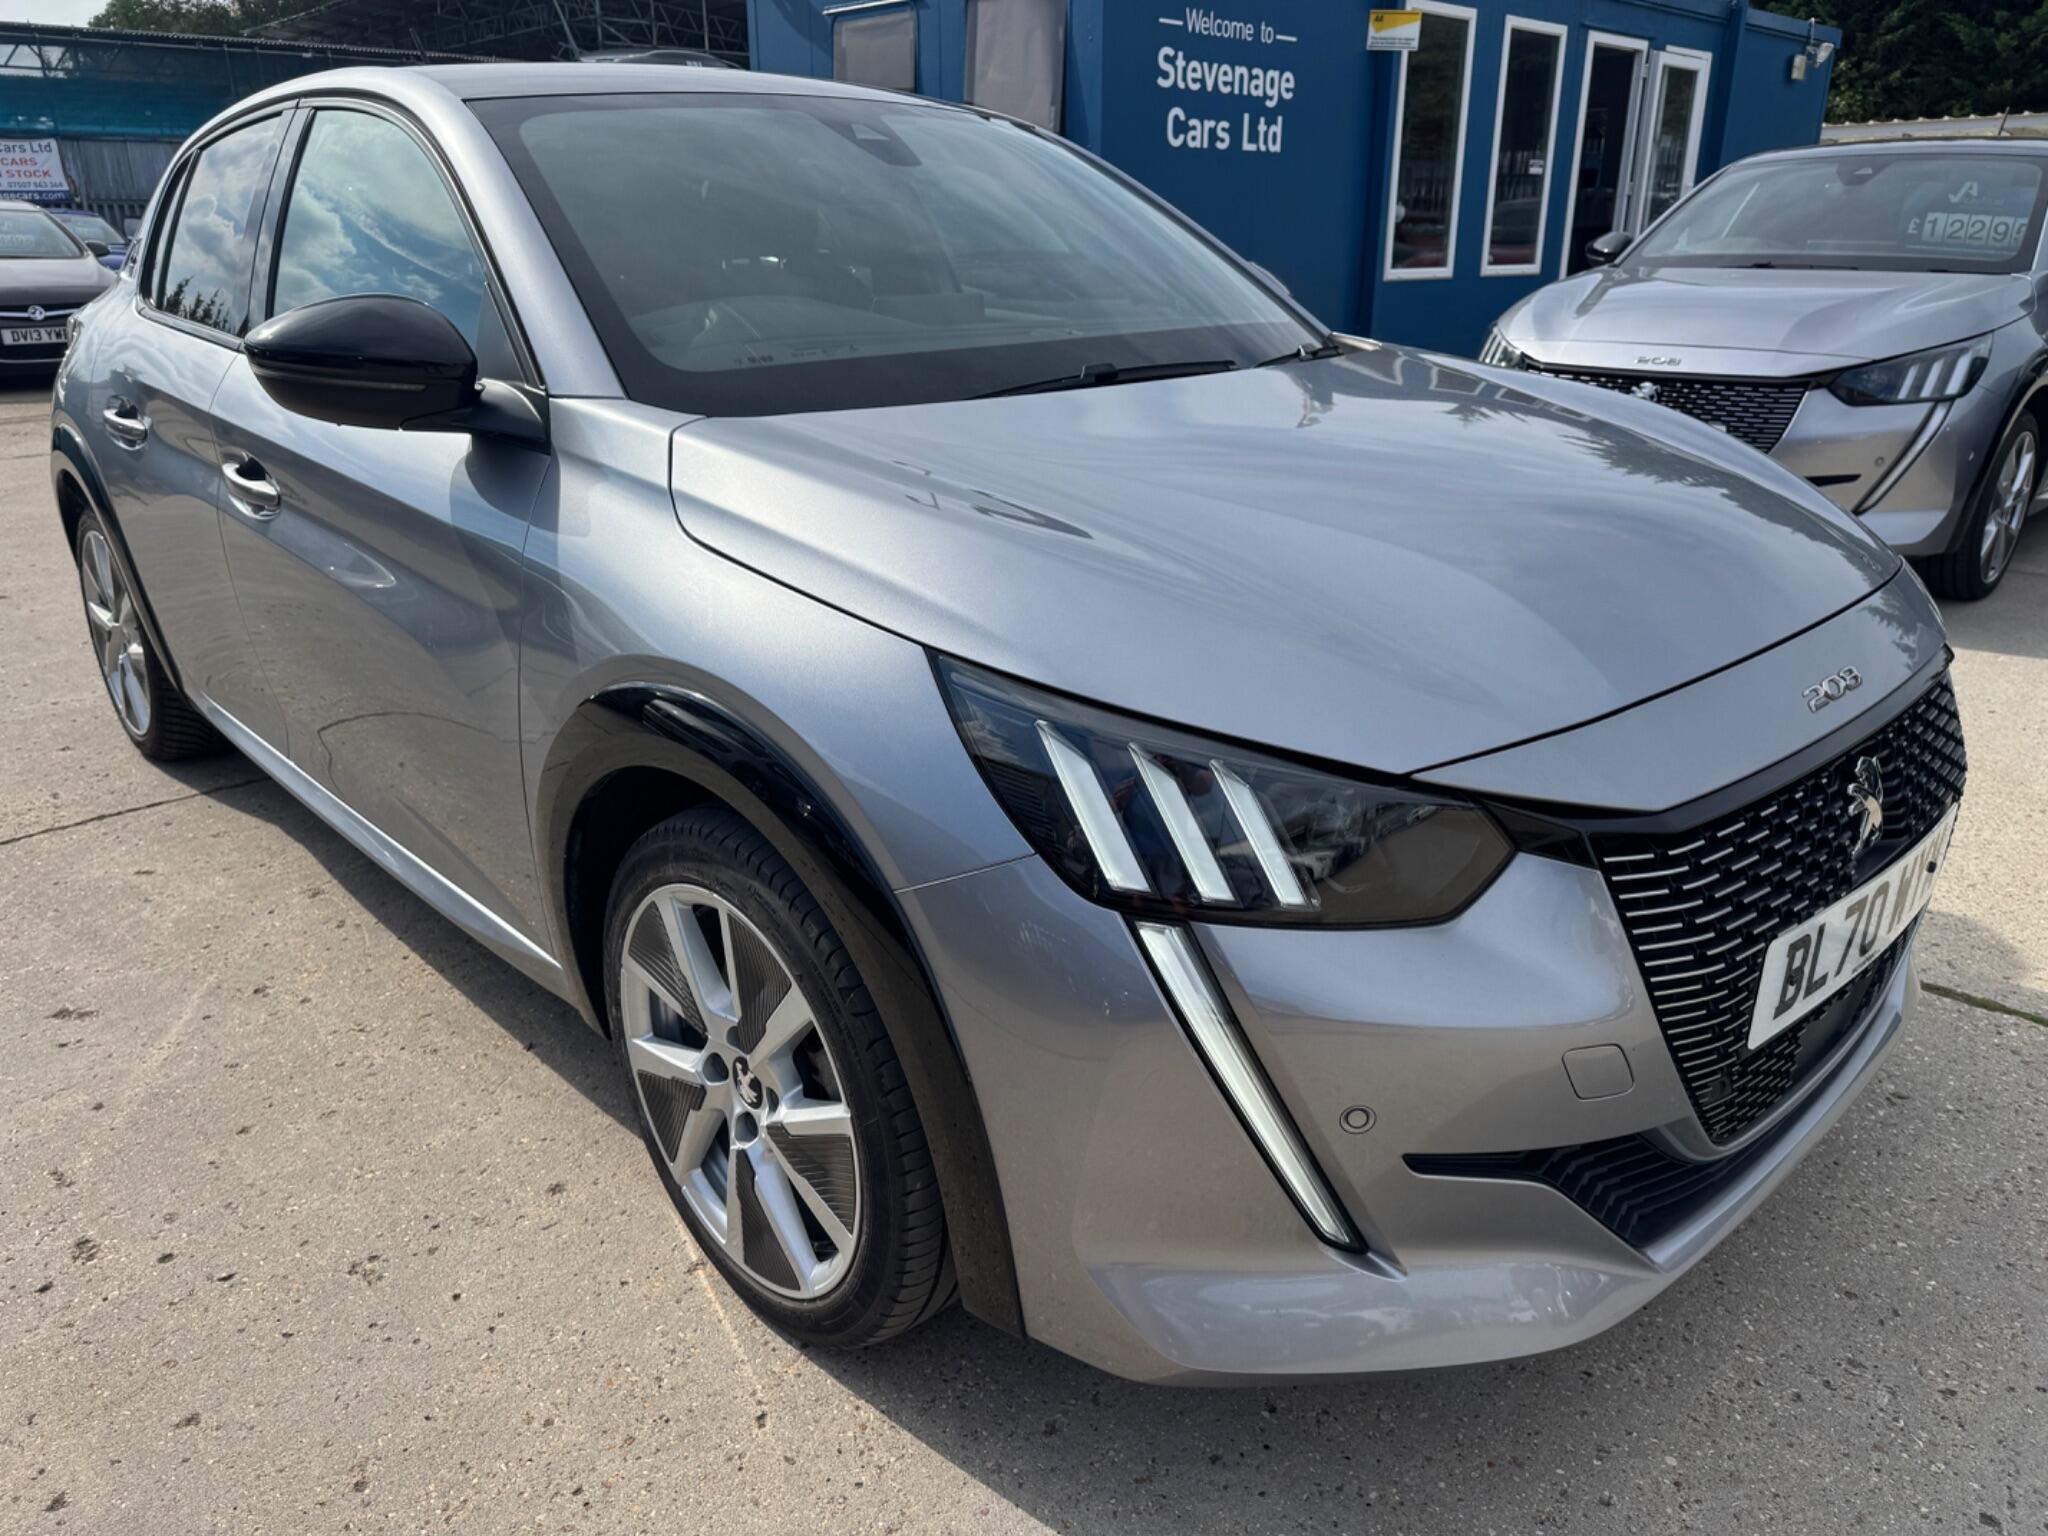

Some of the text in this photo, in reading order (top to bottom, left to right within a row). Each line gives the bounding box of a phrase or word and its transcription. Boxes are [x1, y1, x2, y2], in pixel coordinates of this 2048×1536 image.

[1185, 7, 1275, 45] Welcome to
[1156, 46, 1296, 108] Stevenage
[29, 142, 53, 154] Ltd
[1166, 106, 1283, 153] Cars Ltd
[0, 156, 38, 166] CARS
[5, 169, 52, 178] STOCK
[11, 329, 42, 343] DV13
[1801, 665, 1863, 713] 208
[1772, 881, 1890, 1021] BL70
